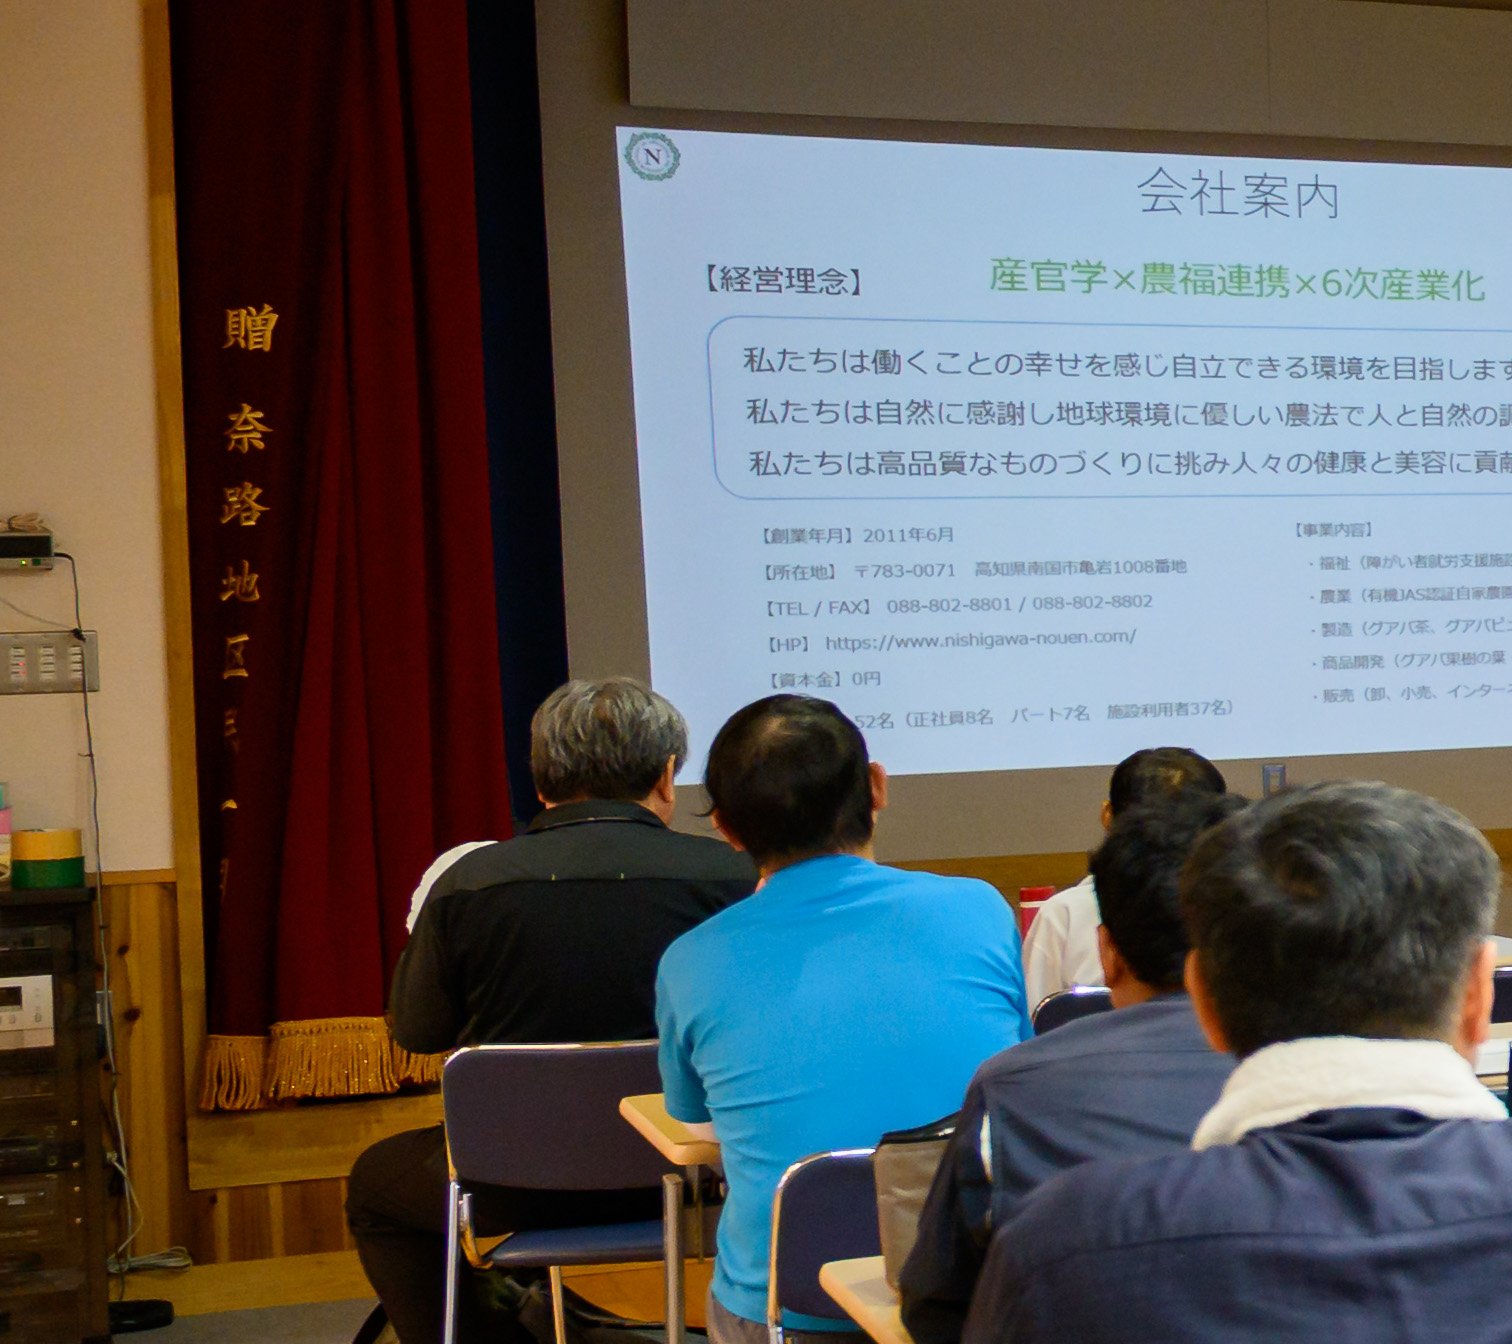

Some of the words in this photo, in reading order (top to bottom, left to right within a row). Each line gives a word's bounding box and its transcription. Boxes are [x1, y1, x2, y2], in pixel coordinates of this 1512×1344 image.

[644, 148, 661, 165] N
[1137, 166, 1338, 219] 会社案内
[705, 263, 860, 297] 【経営理念】
[990, 257, 1485, 302] 産官学×農福連携×6次産業化
[887, 597, 1011, 613] 088-802-8801
[1033, 594, 1153, 610] 088-802-8802
[826, 629, 1136, 653] https://www.nishigawa-nouen.com/
